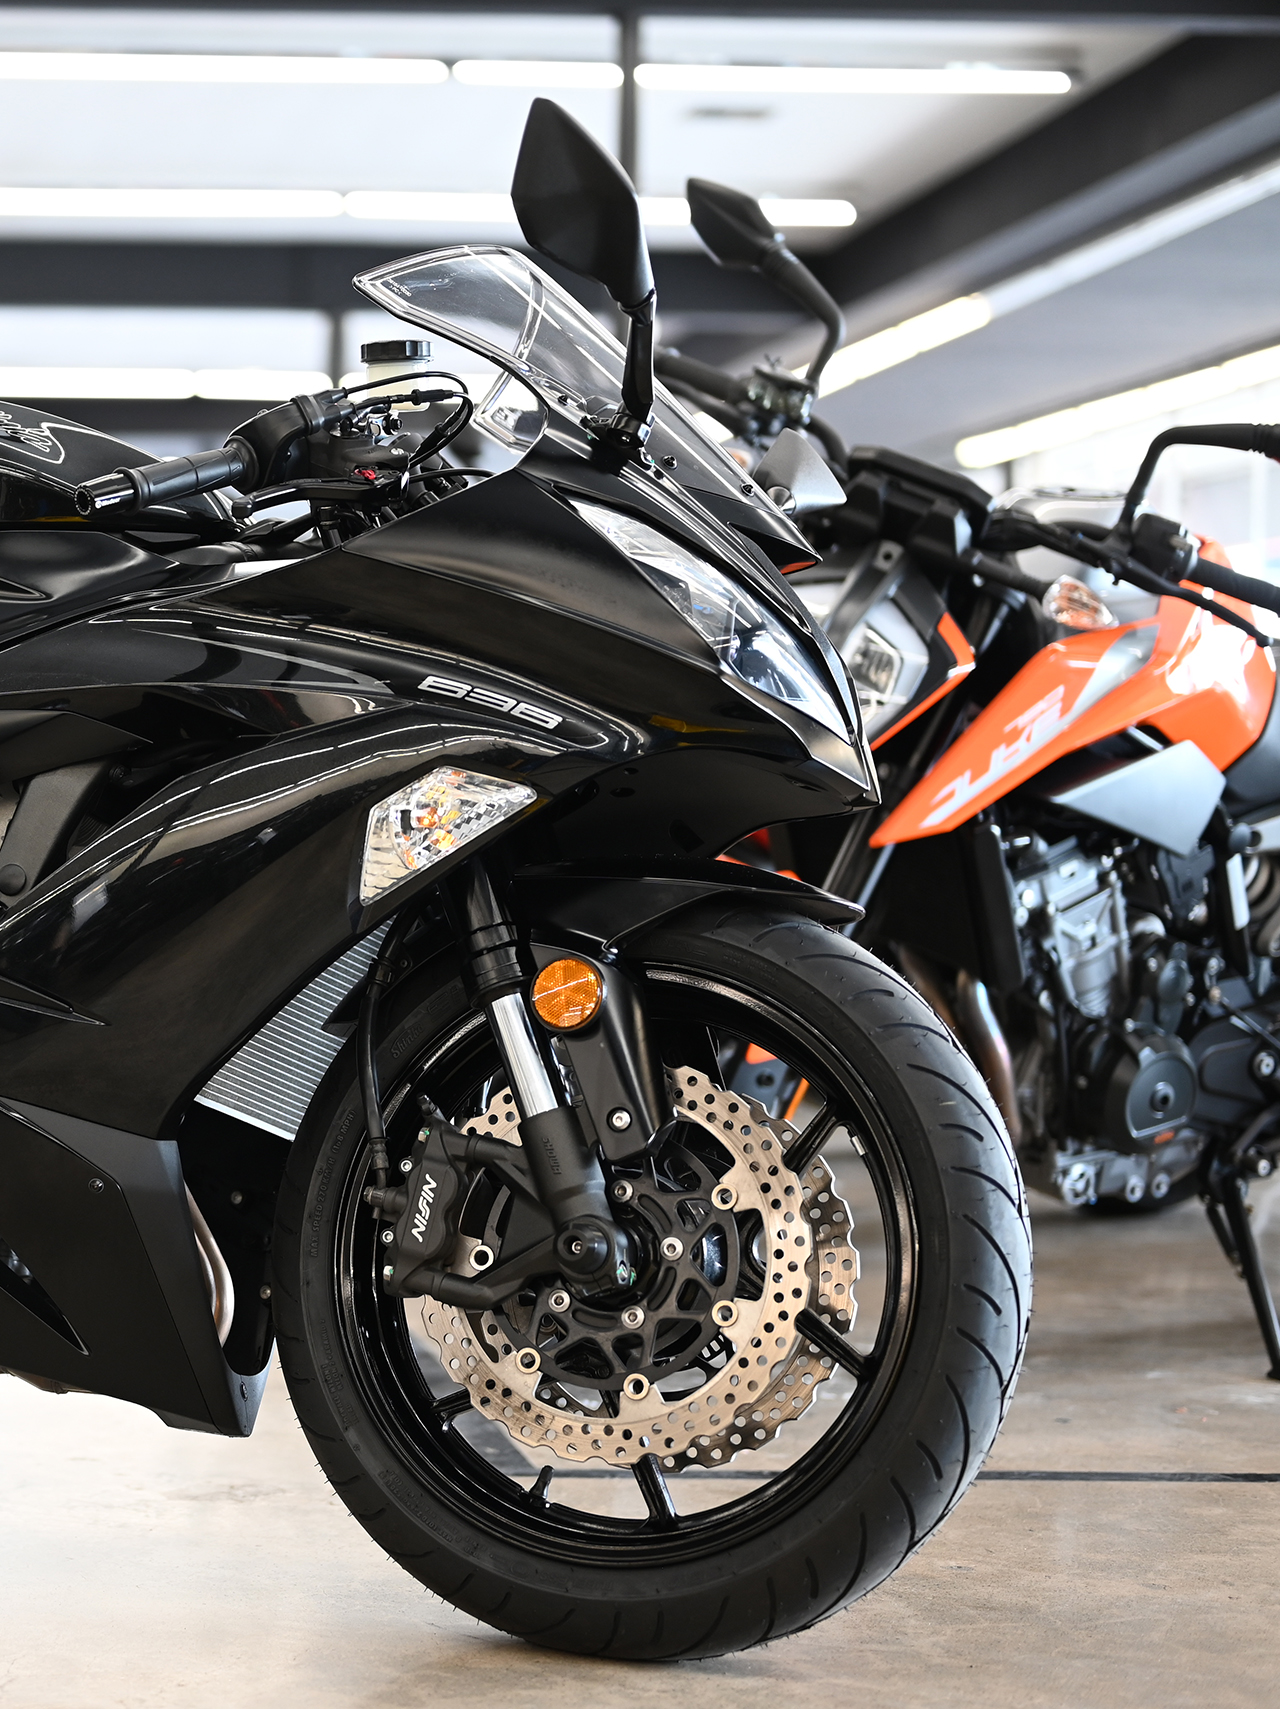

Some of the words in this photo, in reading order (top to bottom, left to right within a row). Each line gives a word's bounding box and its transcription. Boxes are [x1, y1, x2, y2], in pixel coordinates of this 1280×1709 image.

[417, 674, 564, 730] 636
[391, 1022, 424, 1058] Shinko
[317, 1185, 328, 1204] 270
[312, 1205, 324, 1232] SPEED
[310, 1237, 320, 1259] MAX
